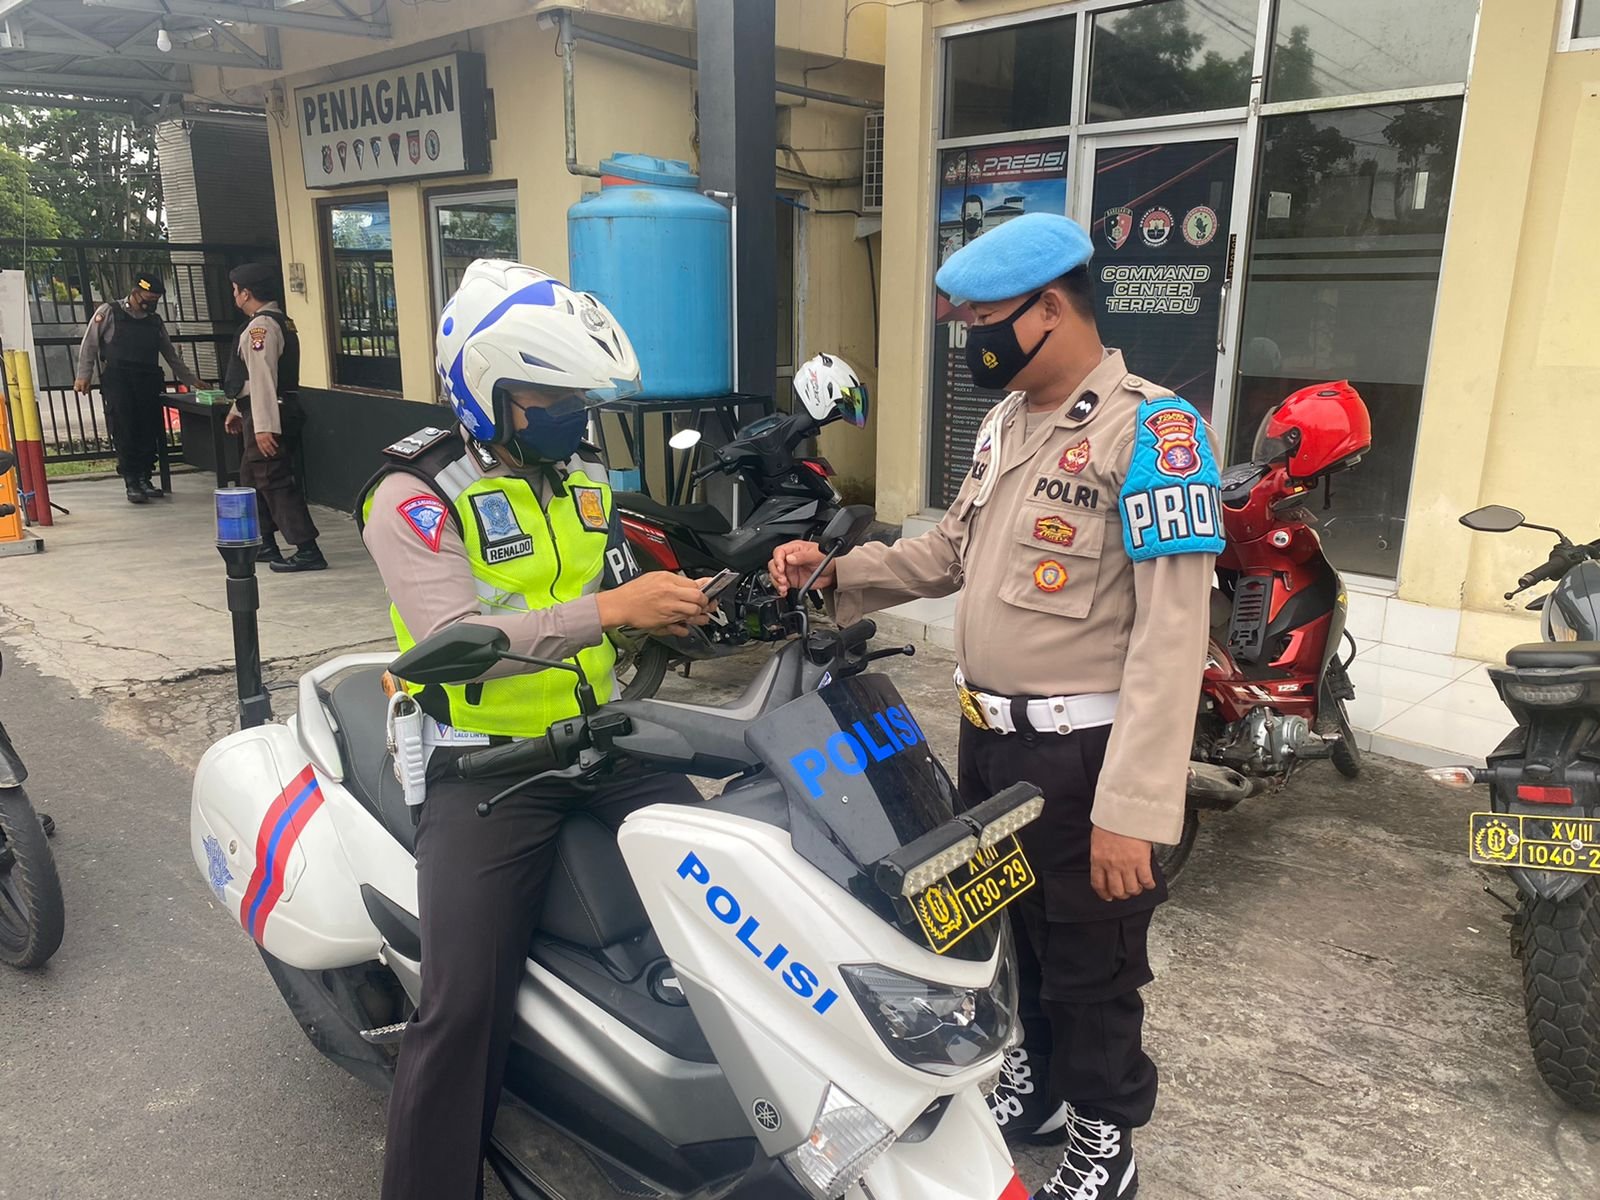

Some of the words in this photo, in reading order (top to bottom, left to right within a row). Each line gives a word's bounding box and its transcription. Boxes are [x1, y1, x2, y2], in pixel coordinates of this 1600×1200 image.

[302, 66, 455, 136] PENJAGAAN
[982, 151, 1067, 172] PRESISI
[1102, 266, 1209, 282] COMMAND
[1114, 282, 1193, 297] CENTER
[1107, 298, 1200, 313] TERPADU
[947, 320, 968, 349] 16
[1033, 477, 1099, 509] POLRI
[490, 540, 531, 561] RENALDO
[606, 538, 642, 585] PA
[789, 703, 925, 801] POLISI
[1551, 822, 1593, 842] XVIII
[1527, 845, 1600, 868] 1040-2
[964, 858, 1027, 915] 1130-29
[676, 850, 839, 1015] POLISI
